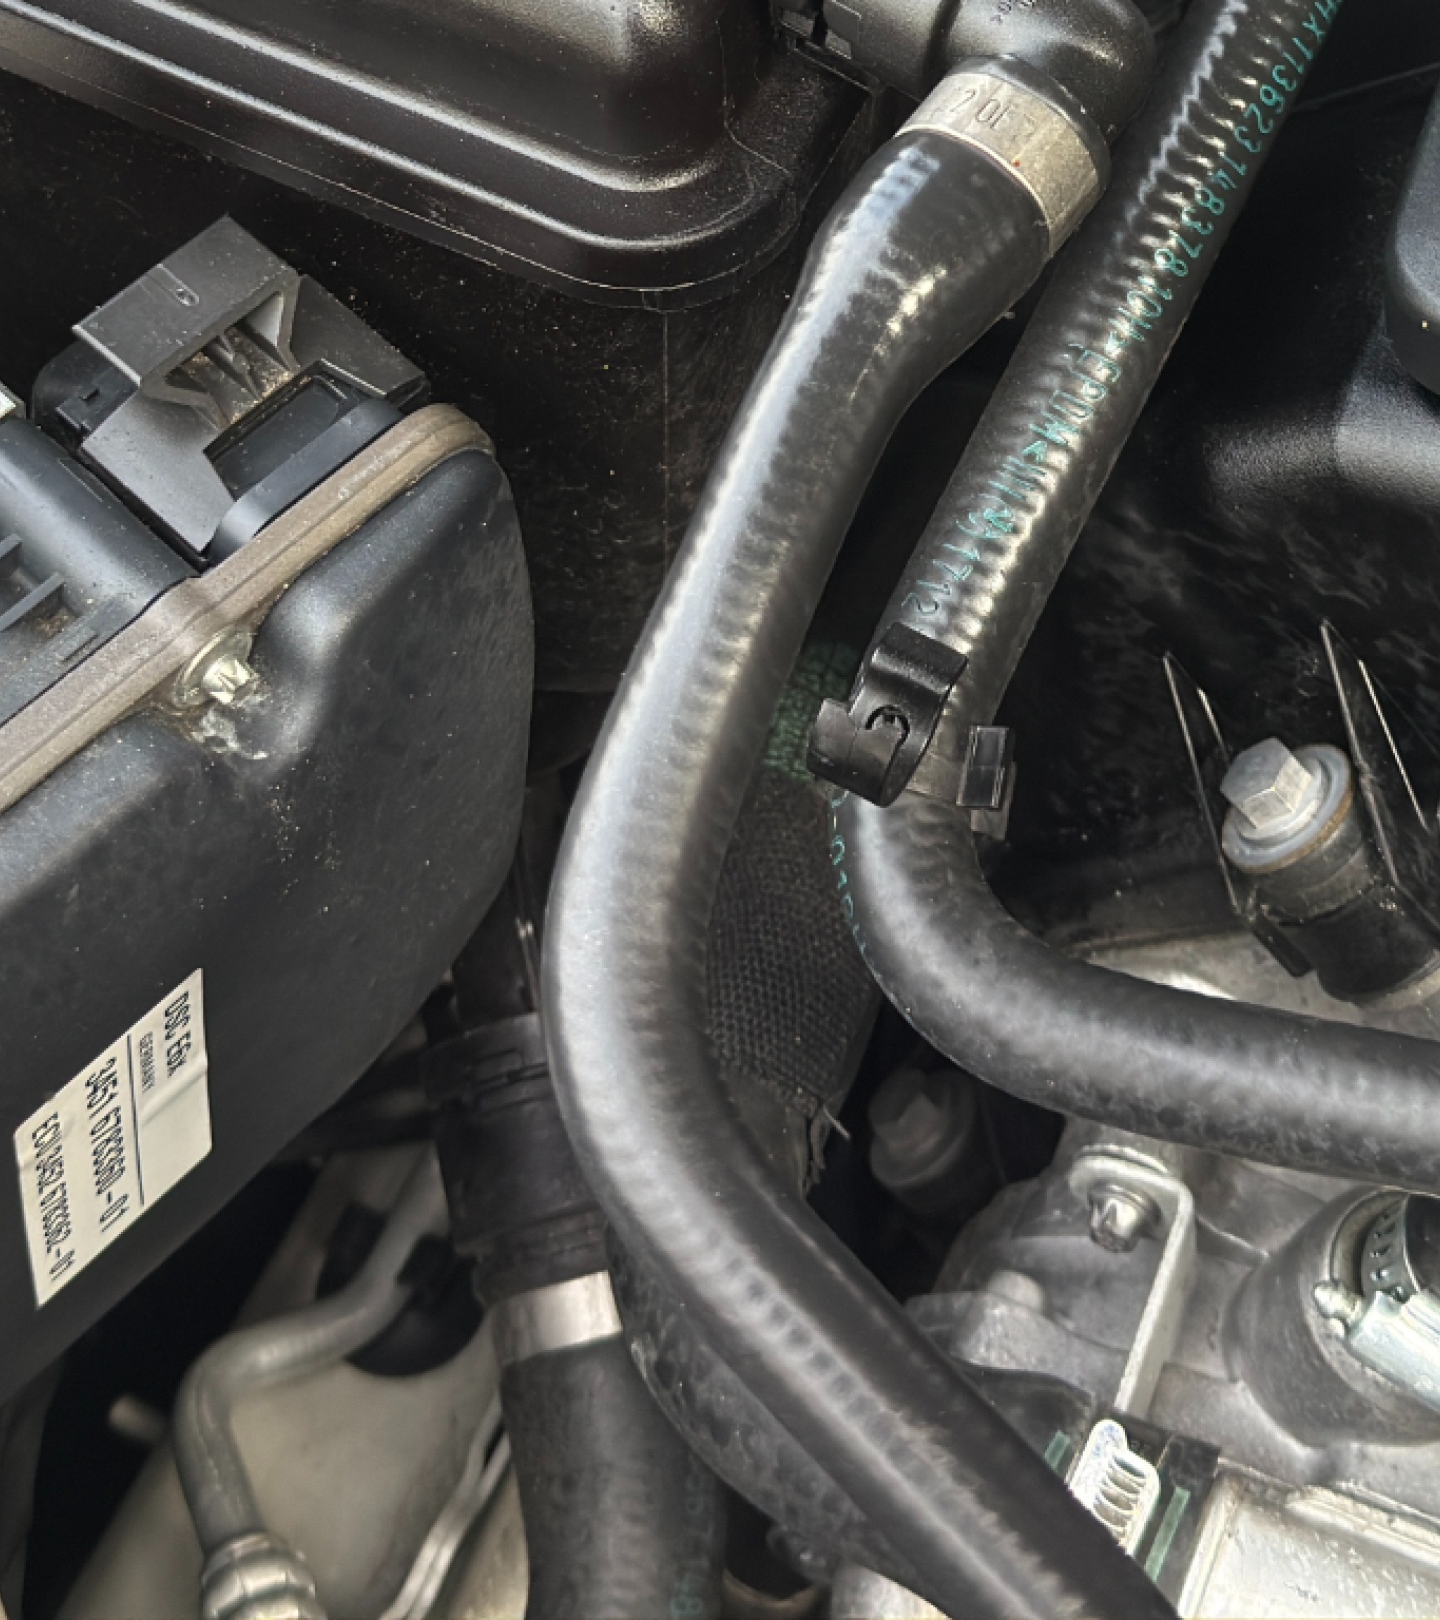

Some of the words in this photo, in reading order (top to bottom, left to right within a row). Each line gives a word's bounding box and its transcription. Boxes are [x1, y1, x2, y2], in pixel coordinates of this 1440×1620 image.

[163, 989, 192, 1042] DSC
[138, 1030, 157, 1094] GERMANY
[166, 1029, 193, 1078] E6x
[84, 1055, 120, 1121] 3451
[30, 1110, 62, 1152] ECU
